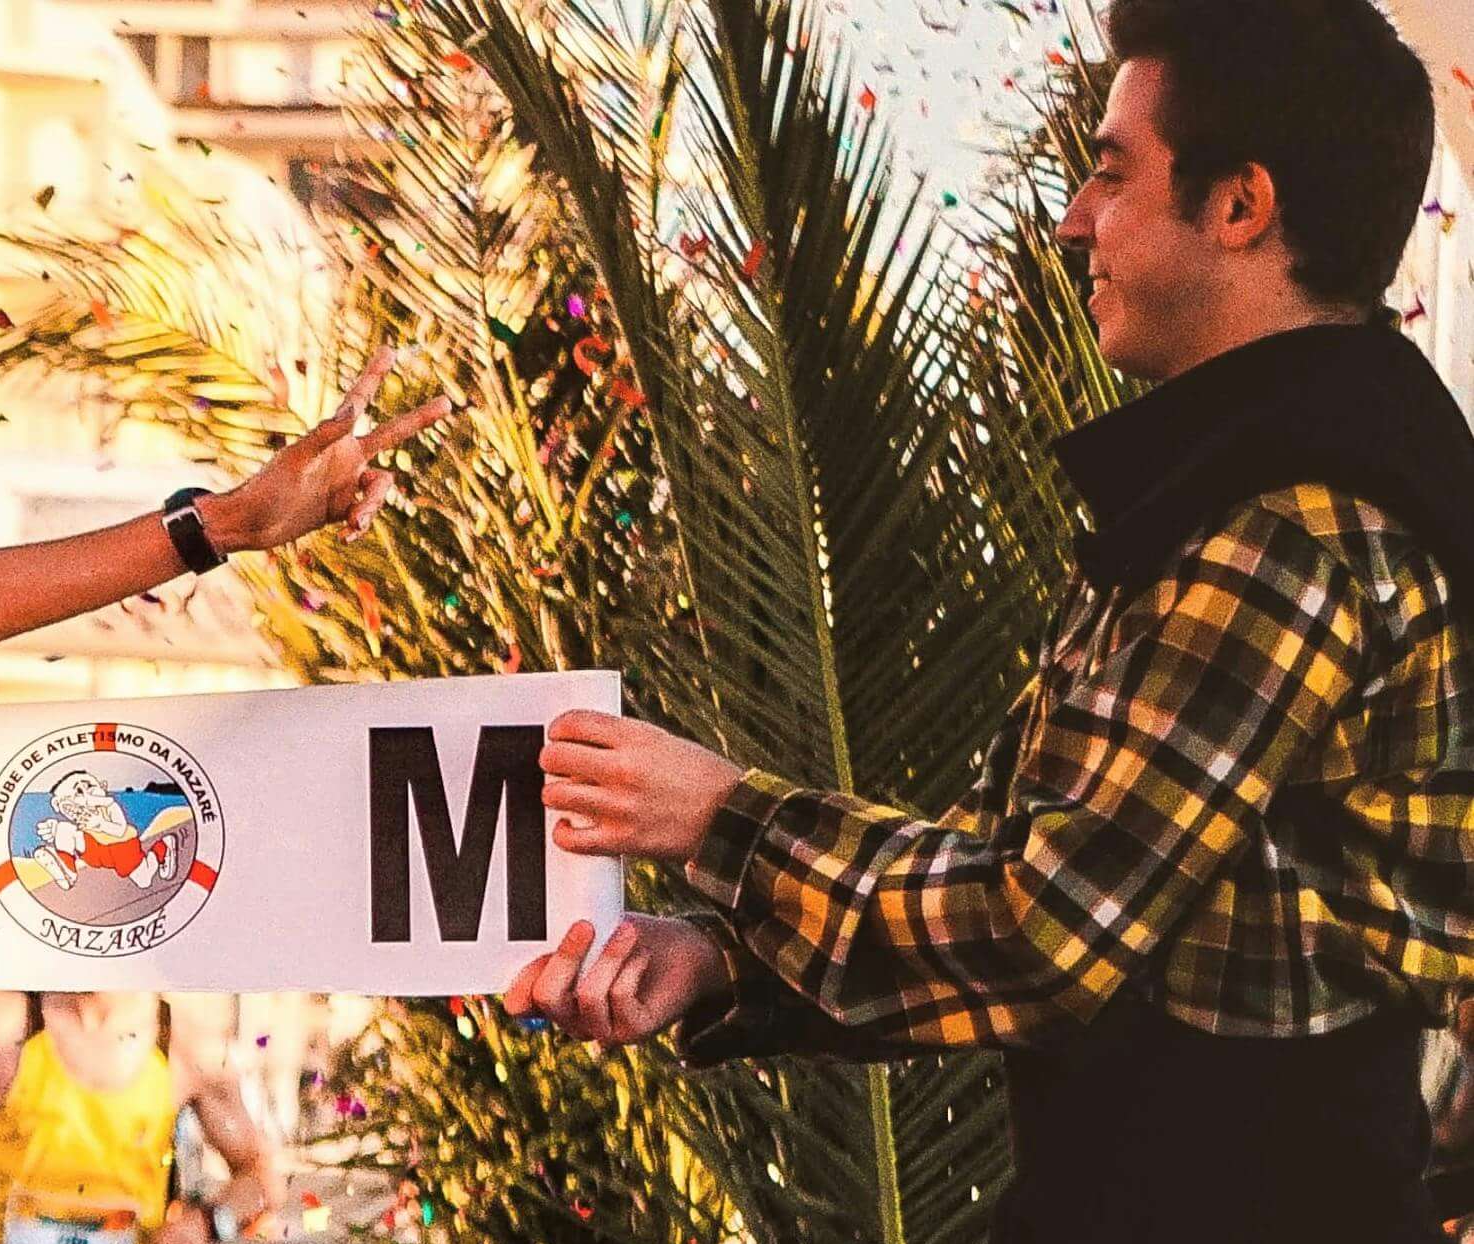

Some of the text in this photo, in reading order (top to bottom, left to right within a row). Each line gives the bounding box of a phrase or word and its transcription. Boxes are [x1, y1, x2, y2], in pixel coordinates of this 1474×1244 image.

[21, 749, 44, 771] DE
[46, 730, 144, 754] ATLETISMO
[148, 741, 170, 762] DA
[171, 758, 218, 825] NAZARÉ
[368, 724, 548, 943] M
[40, 906, 167, 954] NAZARÉ
